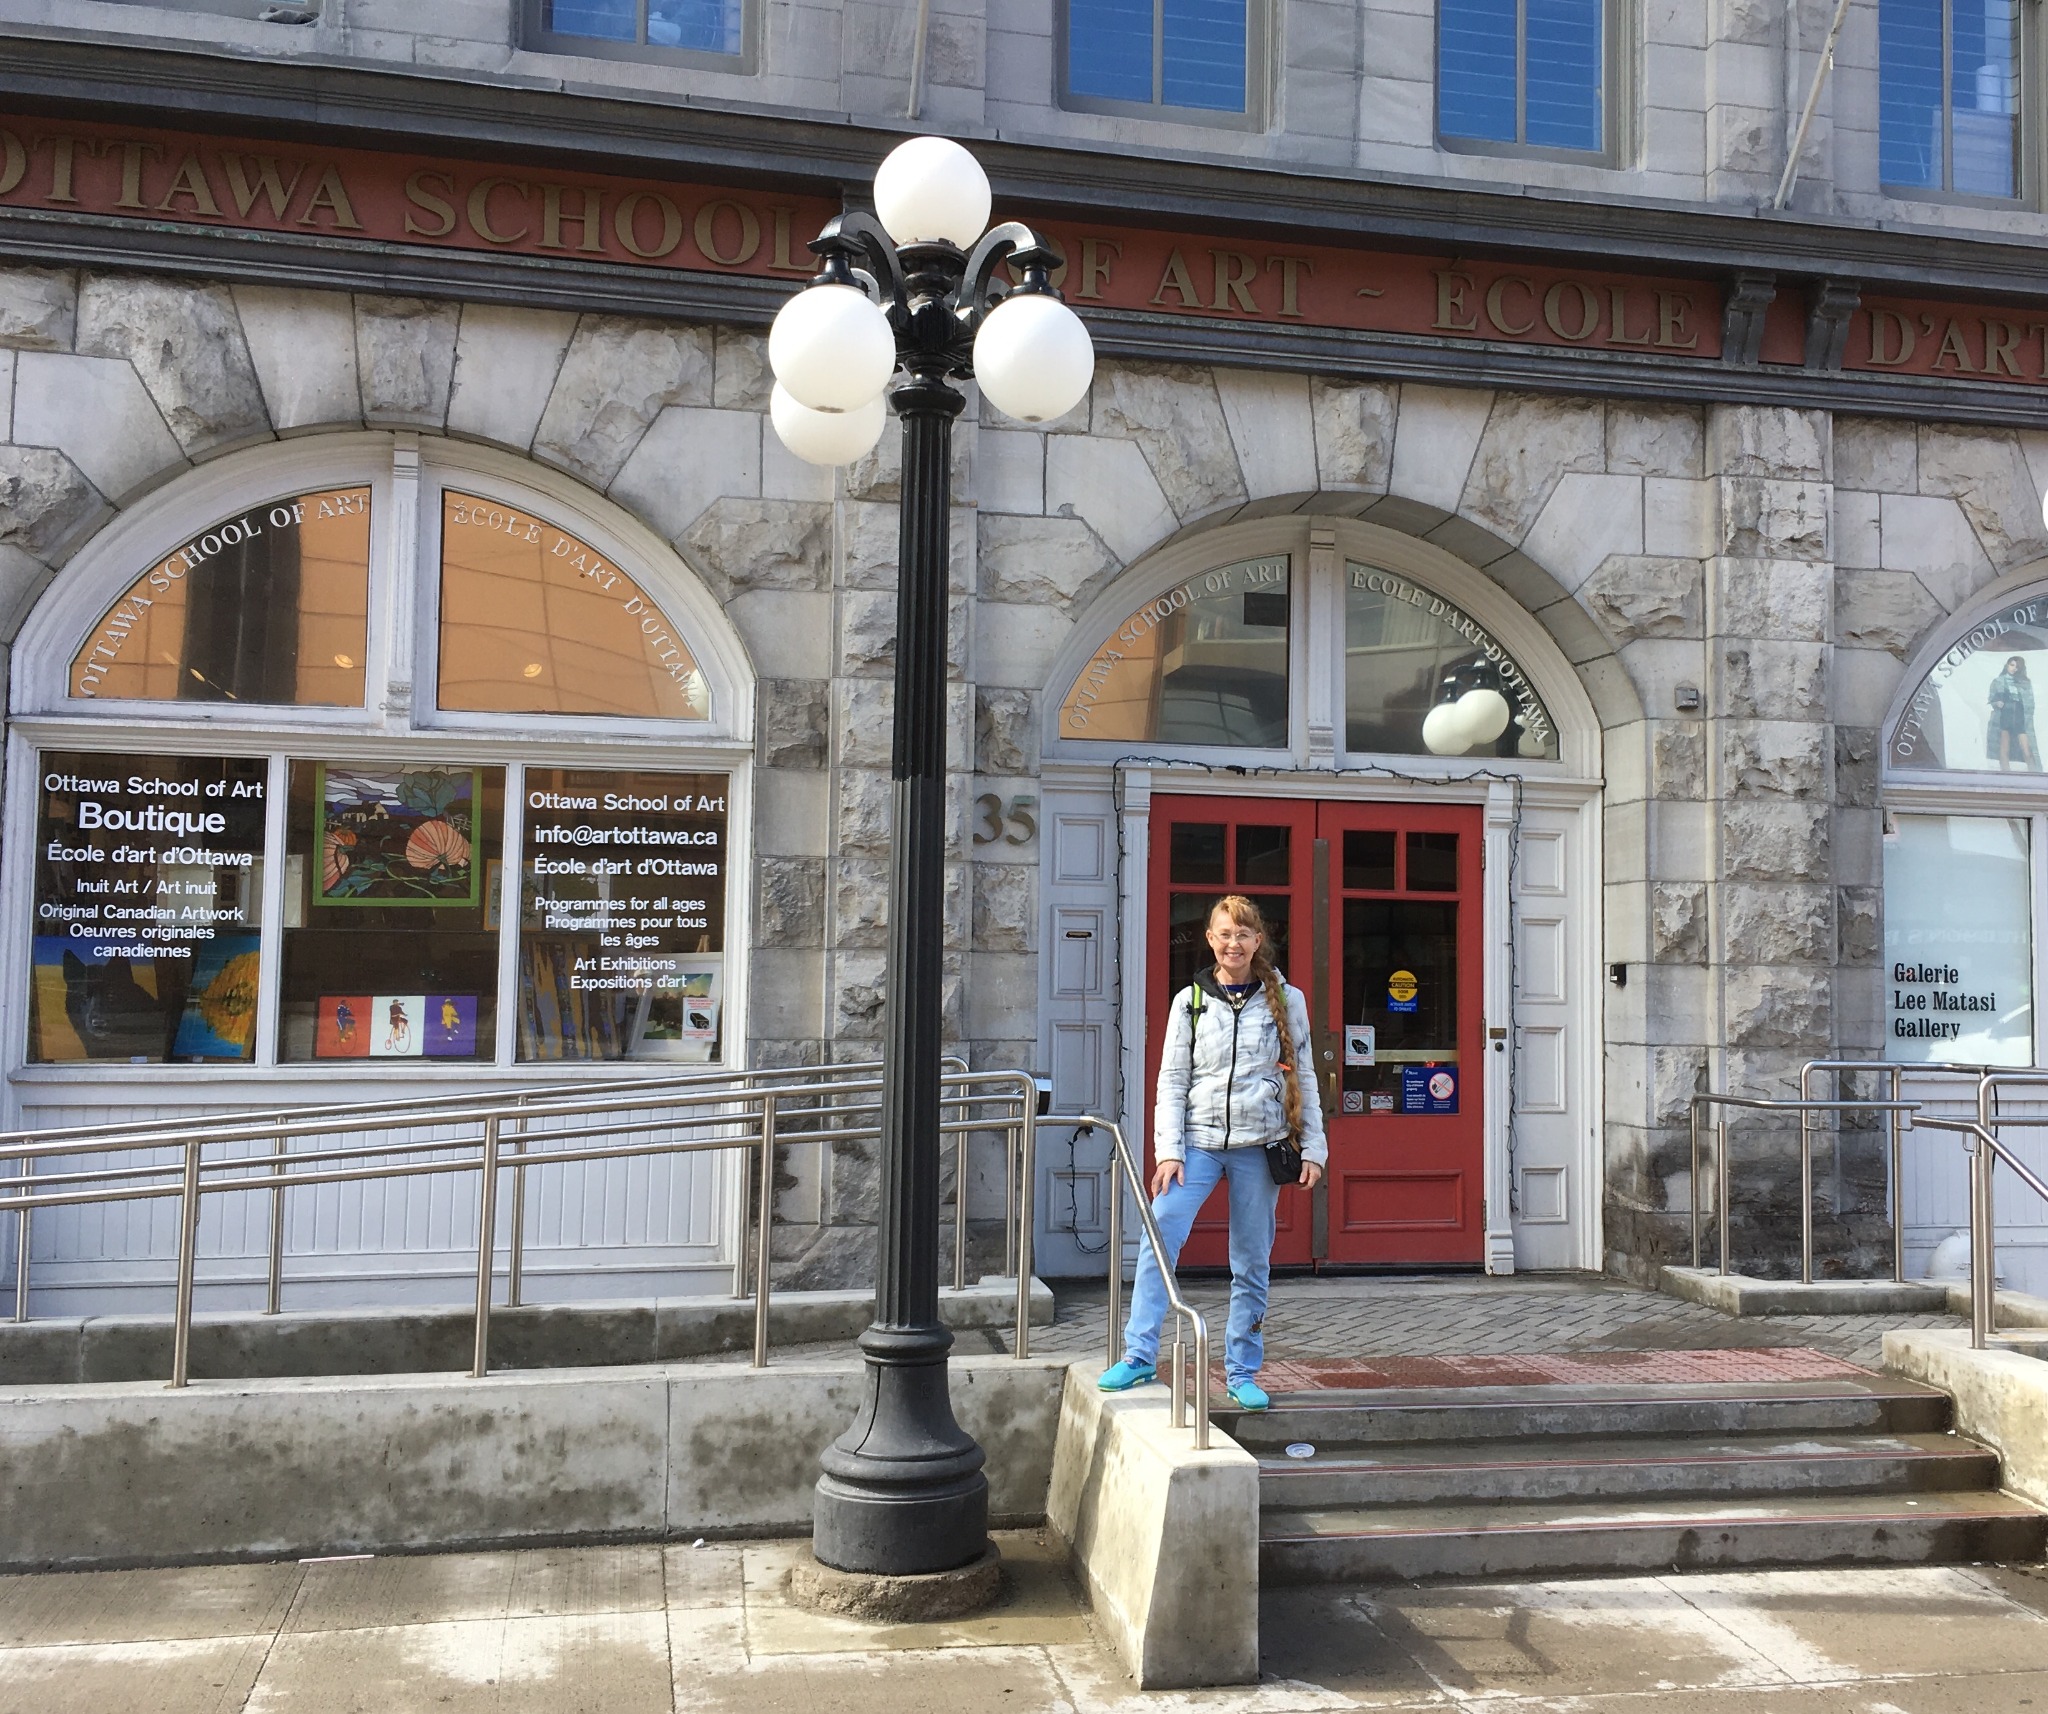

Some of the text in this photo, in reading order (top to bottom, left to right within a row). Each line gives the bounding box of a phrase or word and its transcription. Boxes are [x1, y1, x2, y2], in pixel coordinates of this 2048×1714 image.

[404, 170, 821, 272] SCHOOL
[1150, 247, 1314, 317] ART
[453, 501, 543, 544] ÉCOLE
[80, 493, 369, 698] OTTAWA SCHOOL OF ART
[1069, 564, 1285, 729] OTTAWA SCHOOL OF ART
[1937, 618, 2010, 679] SCHOOL
[2013, 604, 2037, 626] OF
[1352, 568, 1549, 743] ÉCOLE D'ART D'OTTAWA
[44, 773, 264, 798] Ottawa School of Art
[529, 792, 725, 812] Ottawa School of Art
[78, 801, 226, 837] Boutique
[973, 793, 1036, 846] 35
[535, 825, 718, 846] info@artottawa.ca
[47, 839, 253, 866] École d'art d'Ottawa
[534, 854, 718, 876] École d'art d'Ottawa
[76, 878, 218, 895] Inuit Art / Art inuit
[39, 903, 244, 921] Original Canadian Artwork
[535, 896, 706, 913] Programmes for all ages
[69, 923, 215, 942] Oeuvres originales
[545, 915, 708, 931] Programmes pour tous
[93, 943, 191, 958] canadiennes
[600, 933, 660, 948] les âges
[574, 957, 677, 971] Art Exhibitions
[1894, 962, 1959, 984] Galerie
[570, 974, 688, 991] Expositions d'art
[1894, 990, 1997, 1012] Lee Matasi
[1894, 1017, 1961, 1042] Gallery
